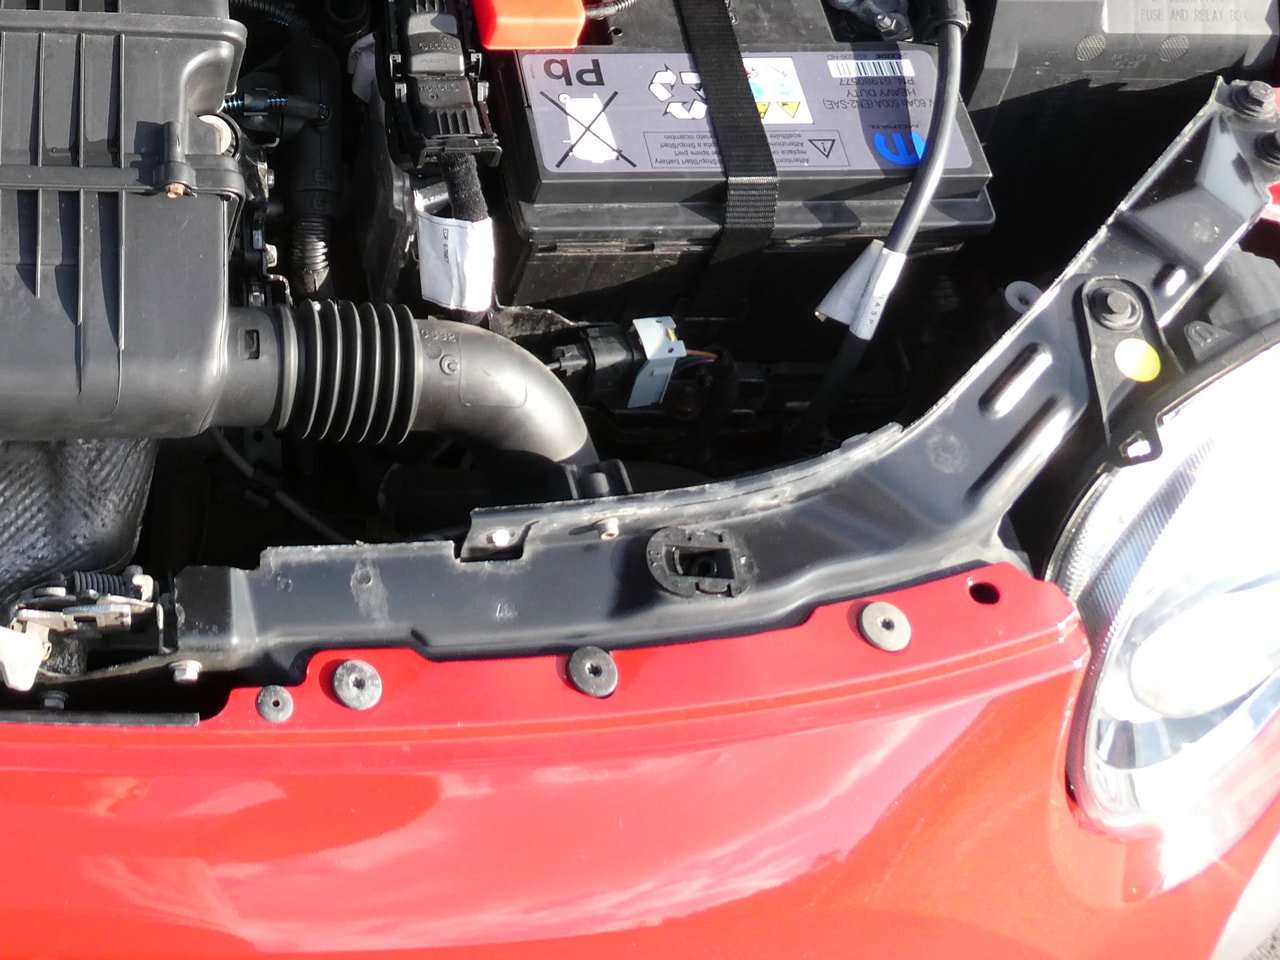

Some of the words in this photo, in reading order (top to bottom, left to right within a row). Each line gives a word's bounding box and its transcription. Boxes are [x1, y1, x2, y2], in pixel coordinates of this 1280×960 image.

[1141, 7, 1163, 22] FUSE
[1170, 7, 1189, 22] AND
[1194, 7, 1223, 22] RELAY
[1229, 7, 1249, 22] BOX
[543, 58, 605, 86] Pb
[846, 87, 877, 97] DUTY
[879, 87, 917, 97] HEAVY
[822, 97, 873, 110] (EN2-SAE)
[874, 98, 899, 109] 500A
[659, 141, 696, 149] Stop/Start
[674, 149, 688, 157] part
[690, 149, 710, 157] spare
[655, 157, 680, 166] battery
[681, 157, 717, 166] Stop/Start
